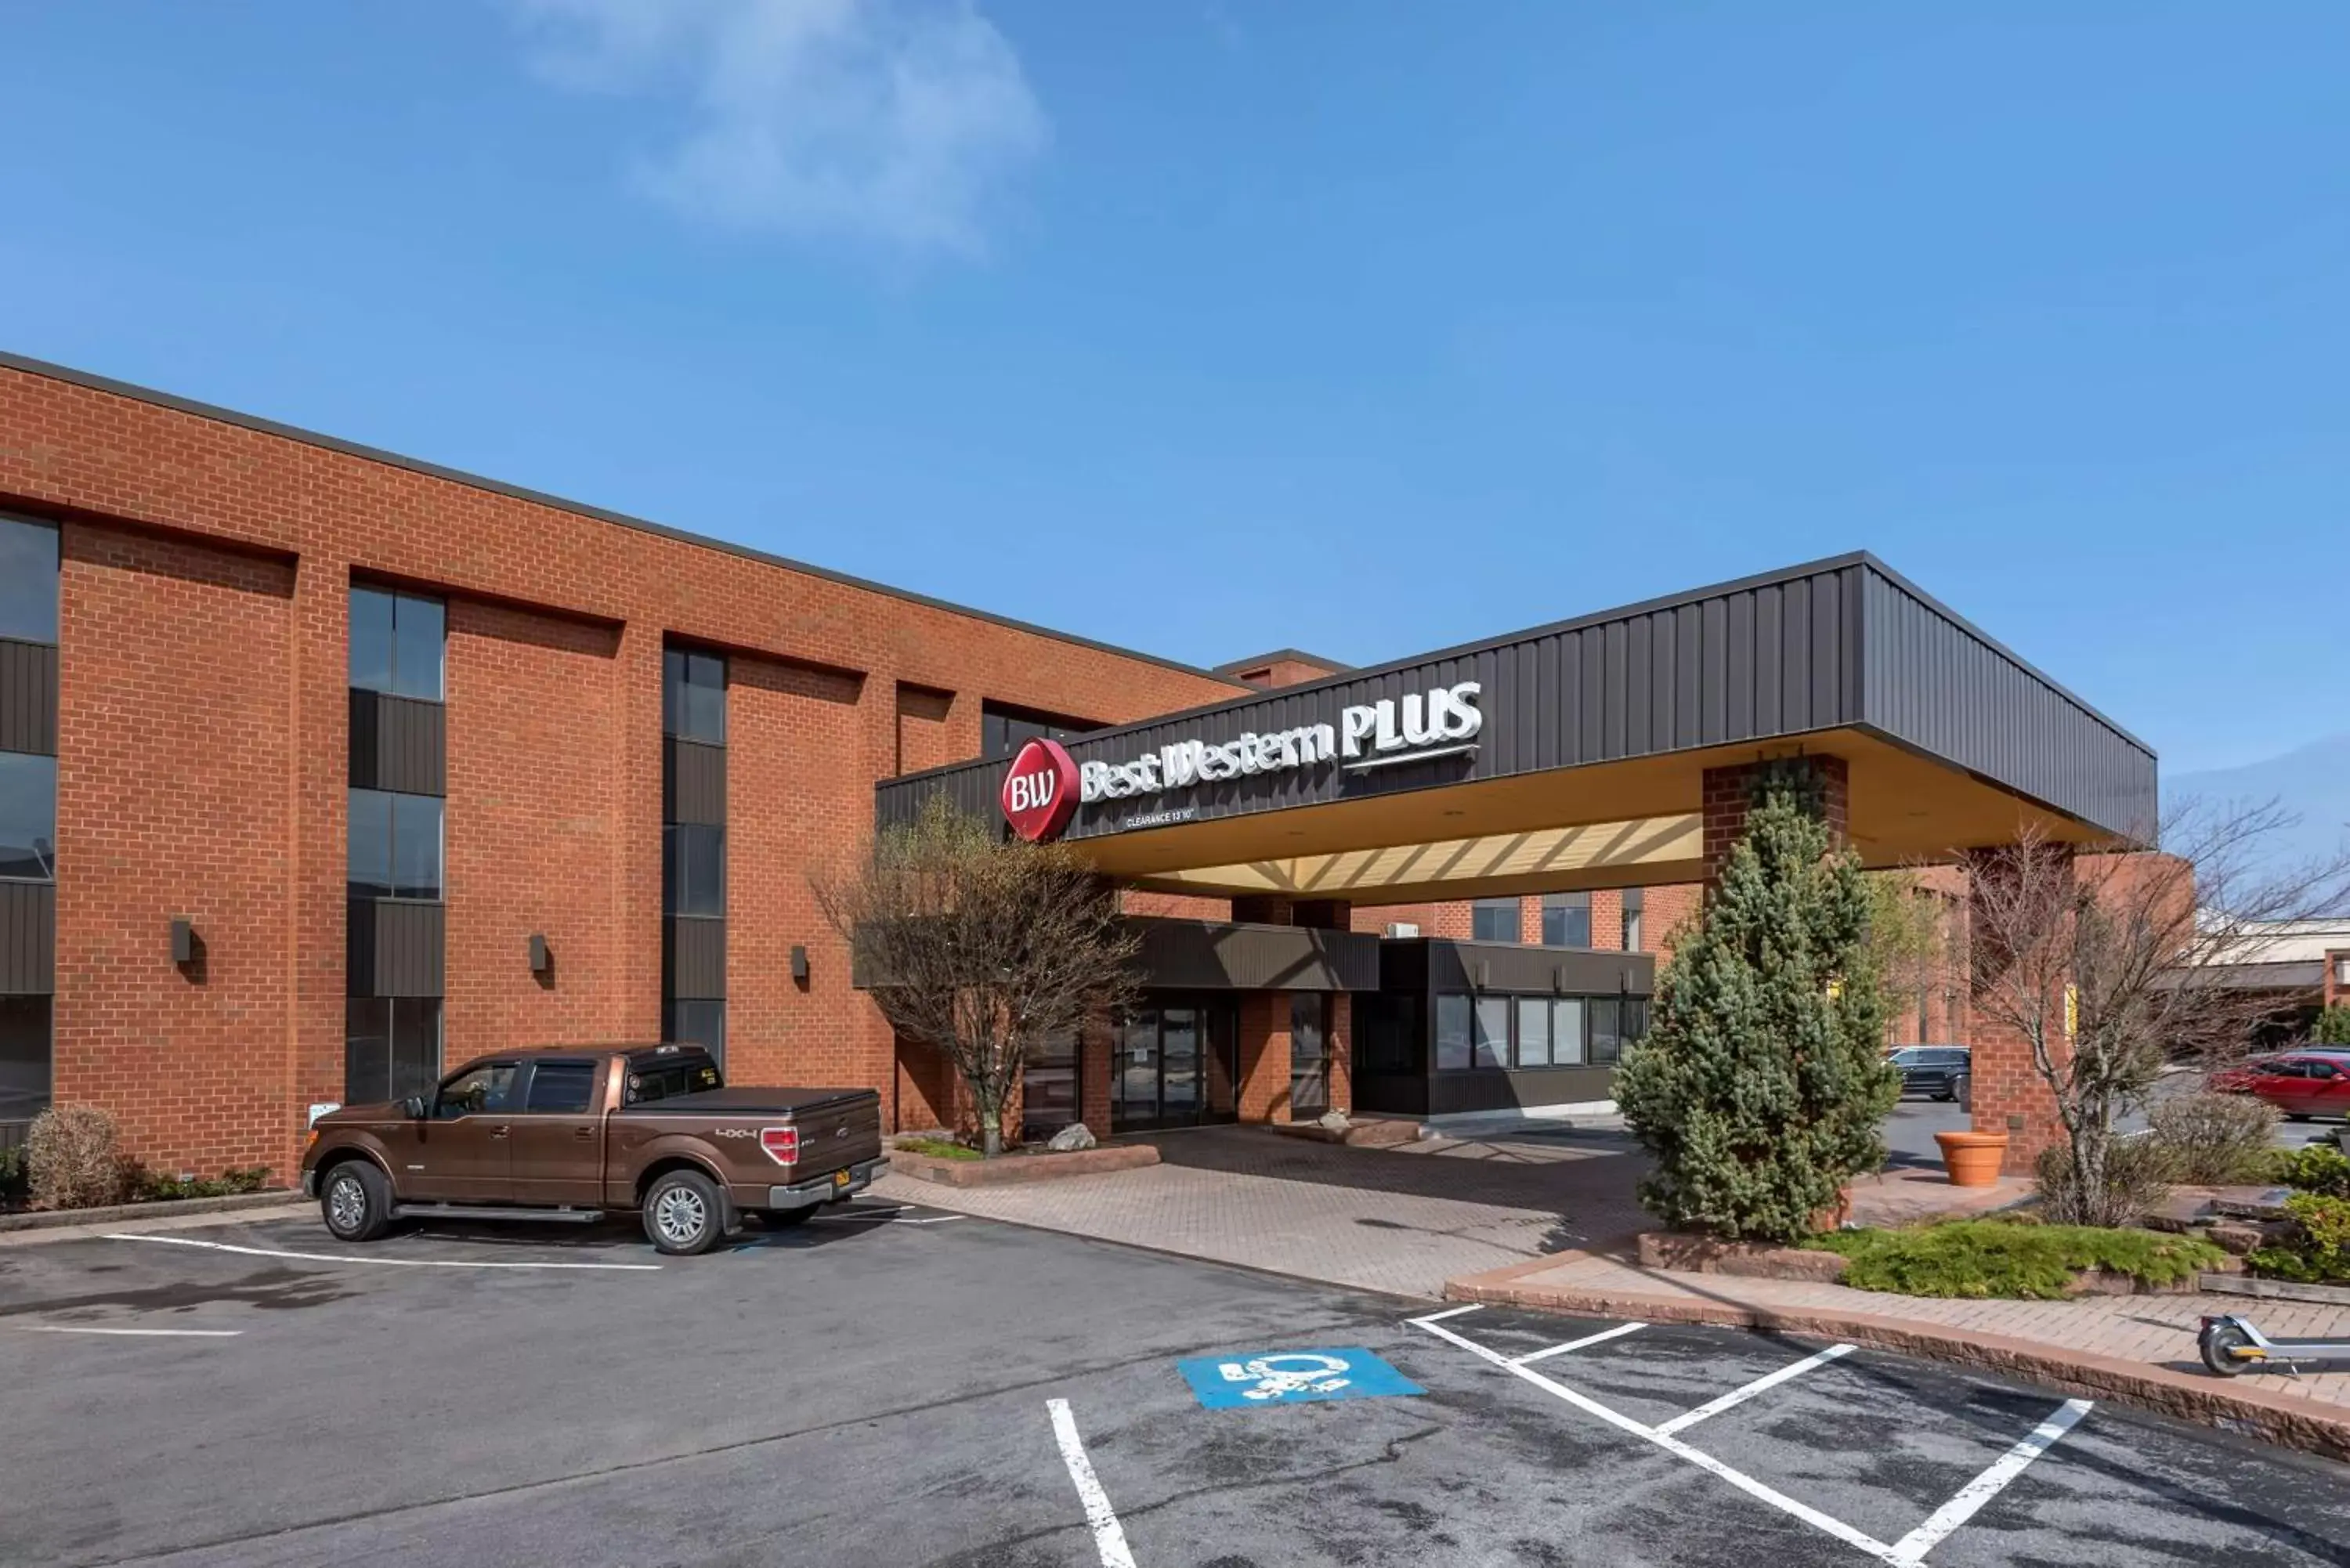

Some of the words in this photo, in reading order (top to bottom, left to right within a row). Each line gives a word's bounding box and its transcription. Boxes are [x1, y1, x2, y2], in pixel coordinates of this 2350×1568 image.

[1080, 753, 1164, 804] Best
[1160, 722, 1336, 788] Western
[1342, 681, 1482, 757] PLUS
[1010, 768, 1054, 812] BW
[1127, 811, 1170, 828] CLEARANCE
